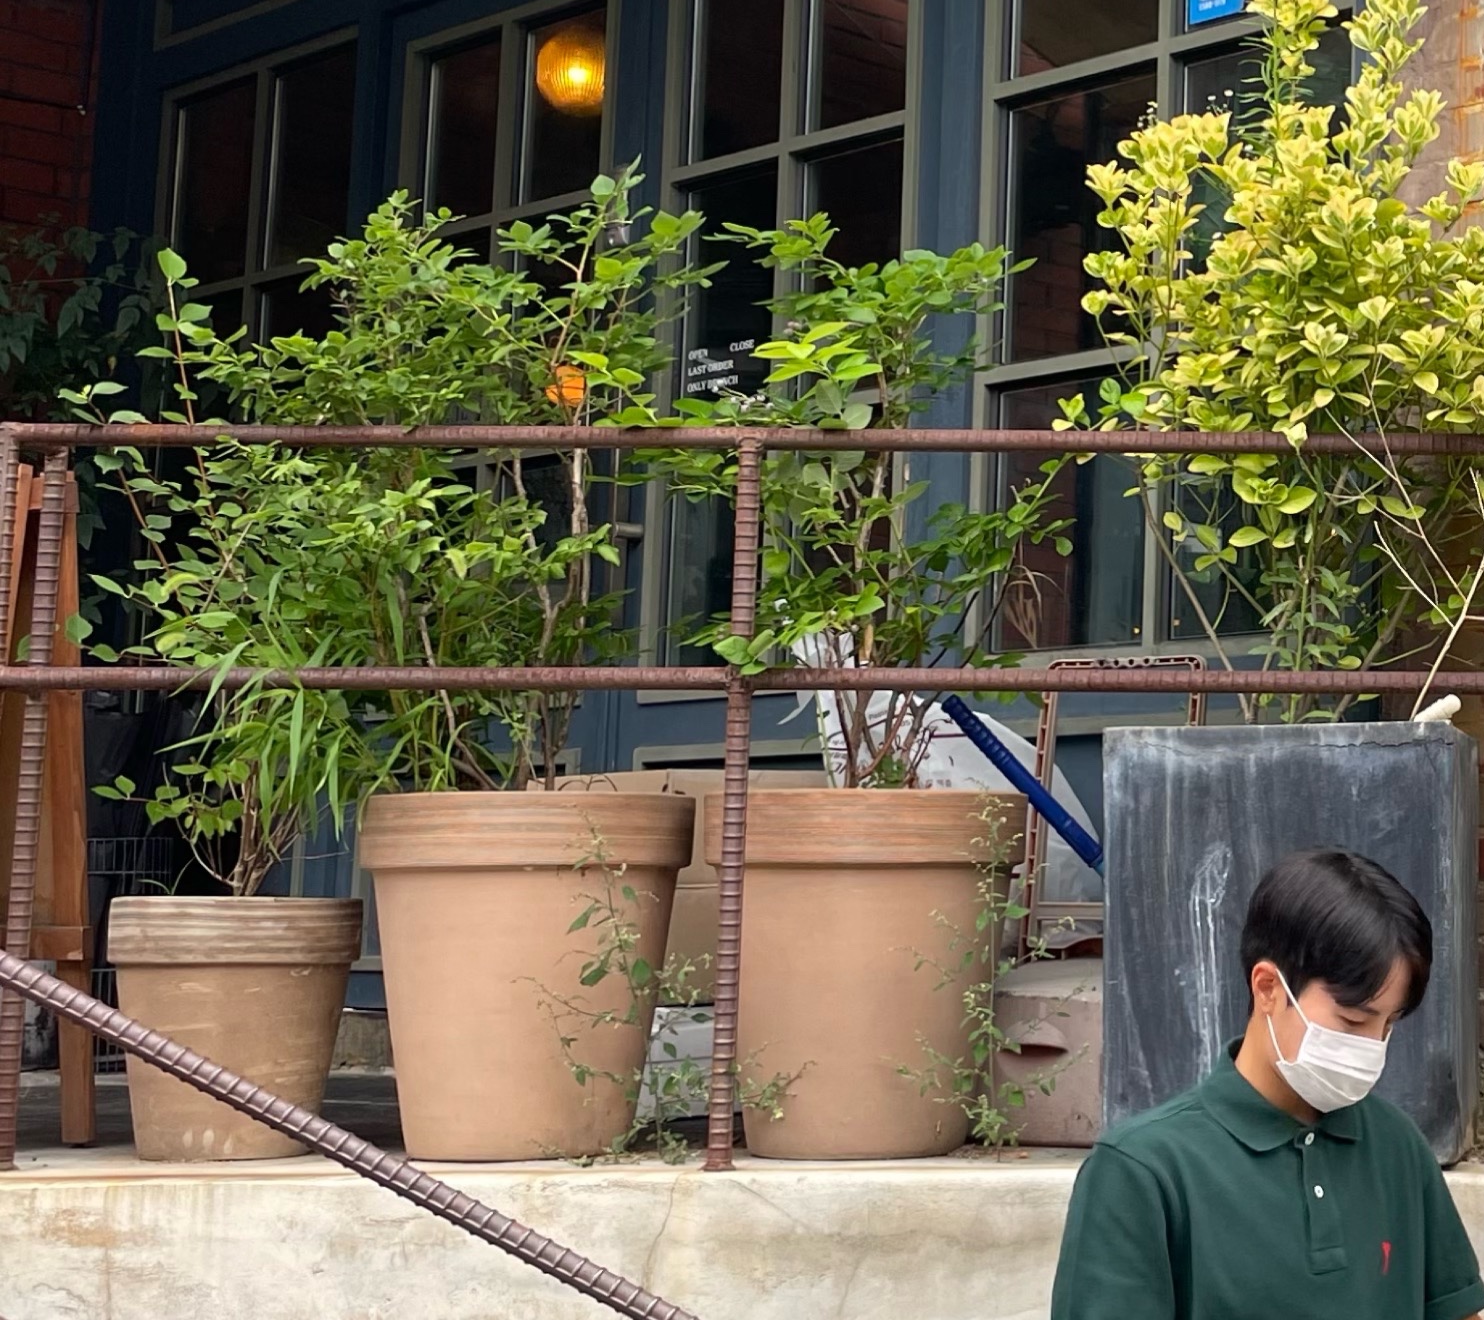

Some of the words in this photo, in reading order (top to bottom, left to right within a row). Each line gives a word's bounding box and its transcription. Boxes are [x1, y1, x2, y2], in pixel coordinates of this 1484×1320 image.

[688, 348, 708, 361] OPEN
[729, 339, 755, 353] CLOSE
[687, 364, 707, 377] LAST
[707, 359, 734, 373] ORDER
[687, 380, 707, 393] ONLY
